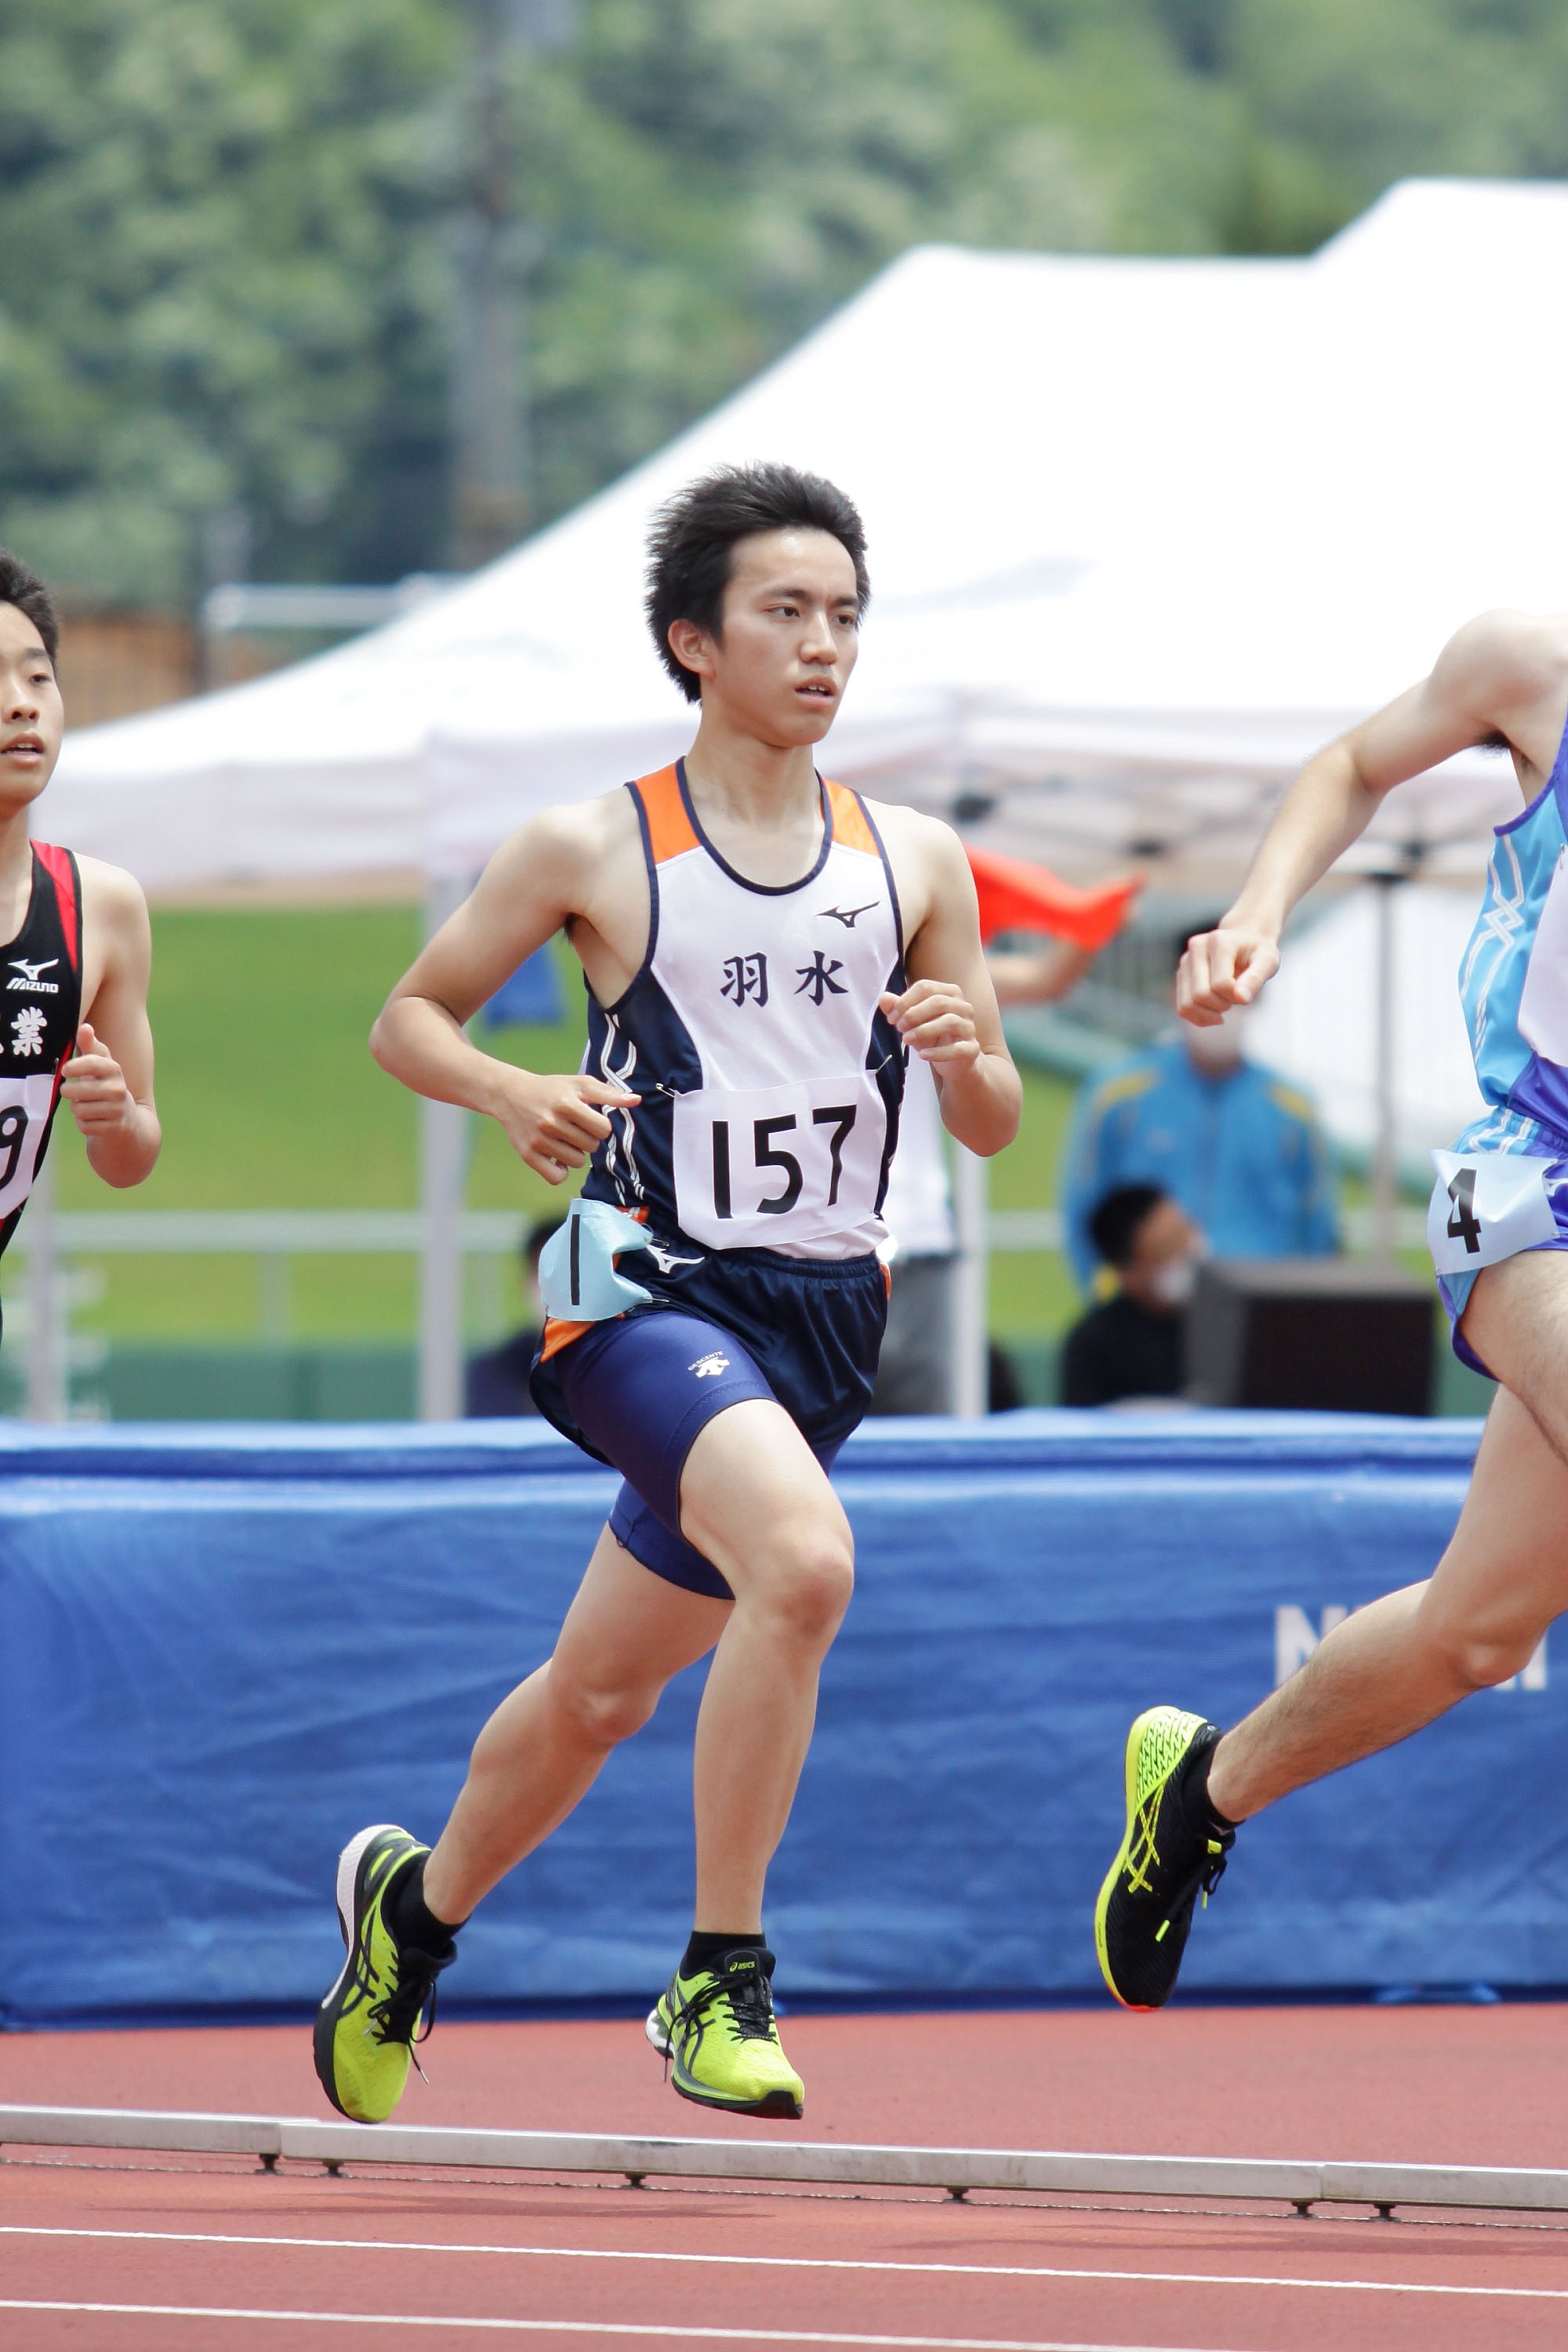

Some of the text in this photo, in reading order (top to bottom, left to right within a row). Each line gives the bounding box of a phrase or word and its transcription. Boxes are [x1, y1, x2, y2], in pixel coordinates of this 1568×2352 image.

[6, 977, 60, 993] MIZUNO
[720, 950, 848, 1007] 羽水
[0, 1006, 47, 1057] 業
[0, 1105, 29, 1191] 9
[711, 1104, 858, 1219] 157
[1447, 1167, 1482, 1254] 4
[570, 1214, 580, 1306] 1
[688, 1350, 724, 1370] DESCENTE
